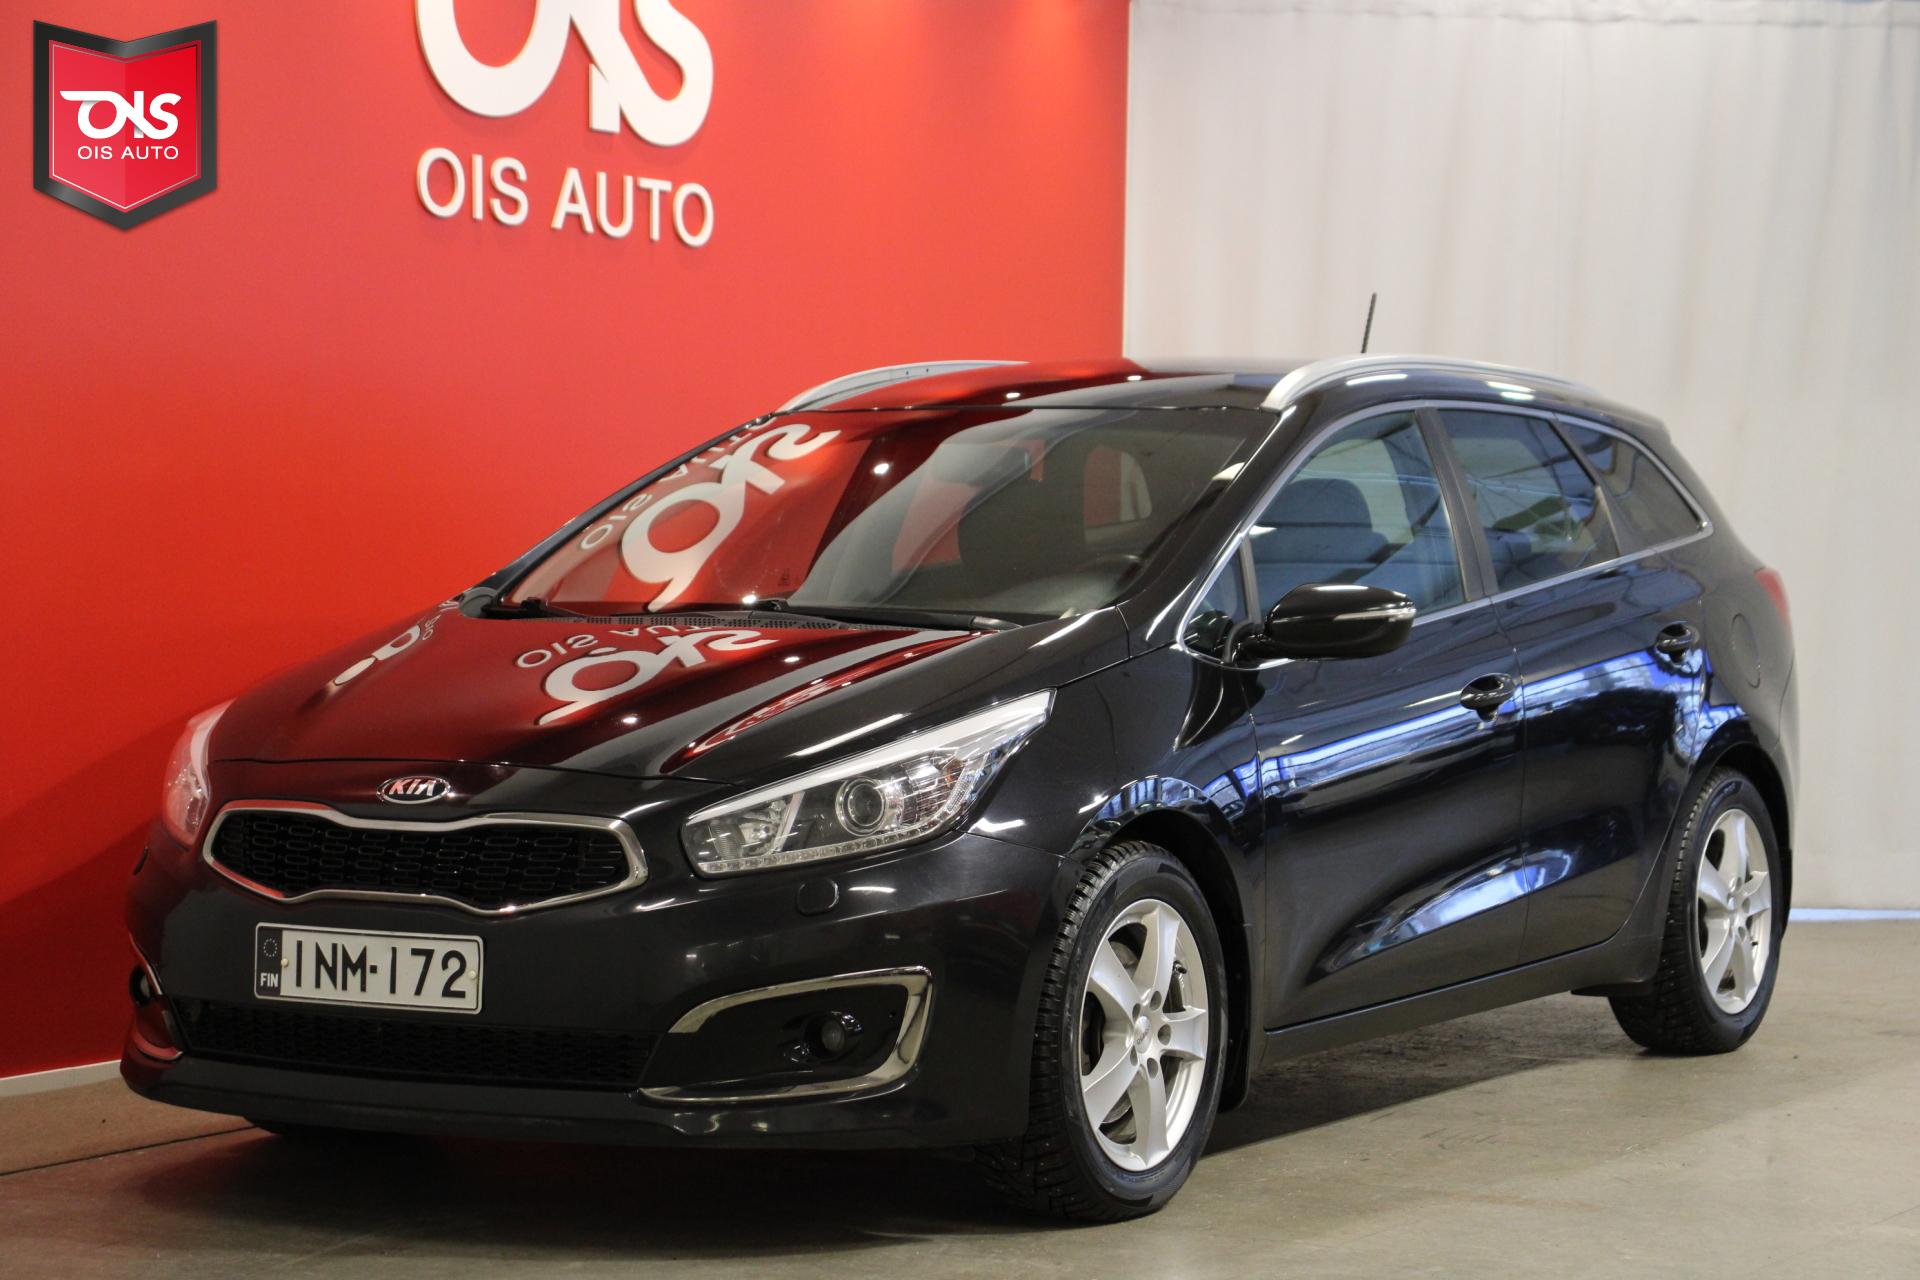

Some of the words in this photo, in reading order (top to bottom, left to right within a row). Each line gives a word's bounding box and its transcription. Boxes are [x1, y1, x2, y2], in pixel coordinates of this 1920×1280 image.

[416, 147, 529, 226] OIS
[551, 167, 714, 248] AUTO
[388, 779, 437, 797] KIA
[260, 972, 279, 988] FIN
[295, 940, 467, 999] INM-172
